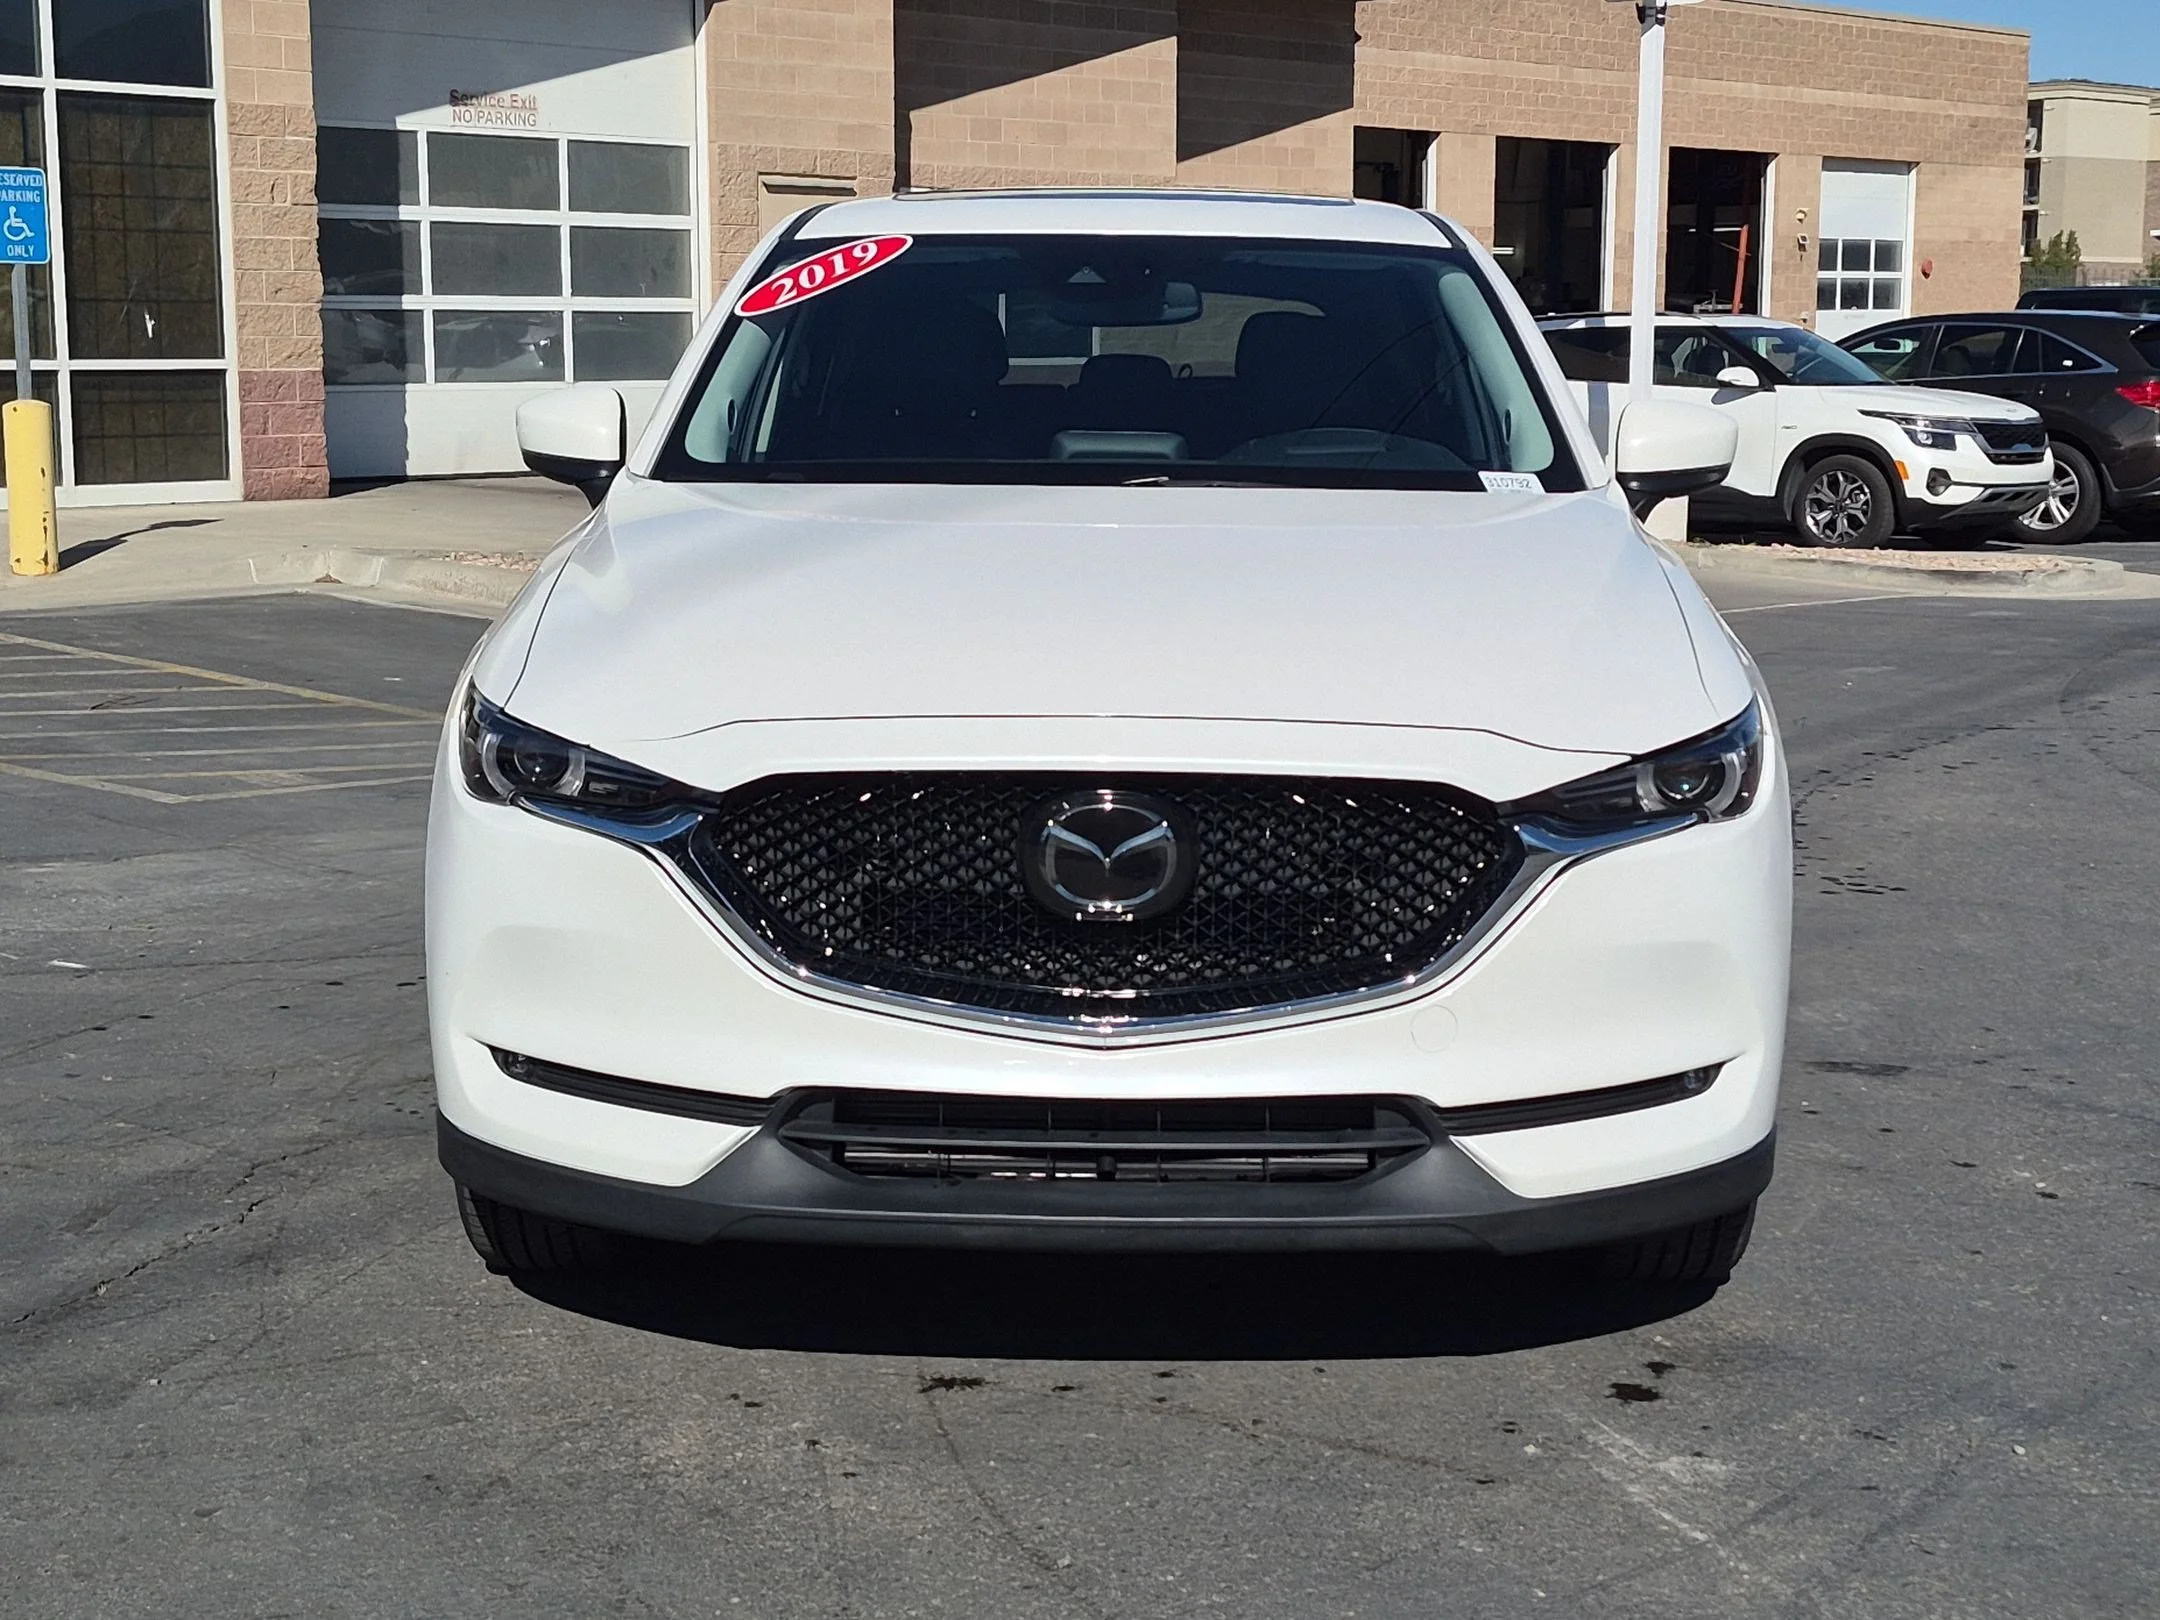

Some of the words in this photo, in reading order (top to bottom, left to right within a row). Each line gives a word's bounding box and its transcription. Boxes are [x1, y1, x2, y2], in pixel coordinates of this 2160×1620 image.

[449, 89, 505, 109] Service
[510, 93, 537, 110] Exit
[452, 109, 473, 123] NO
[477, 110, 537, 127] PARKING
[0, 173, 43, 187] ESERVED
[0, 189, 41, 203] ARKING
[7, 244, 35, 258] ONLY
[771, 241, 878, 305] 2019
